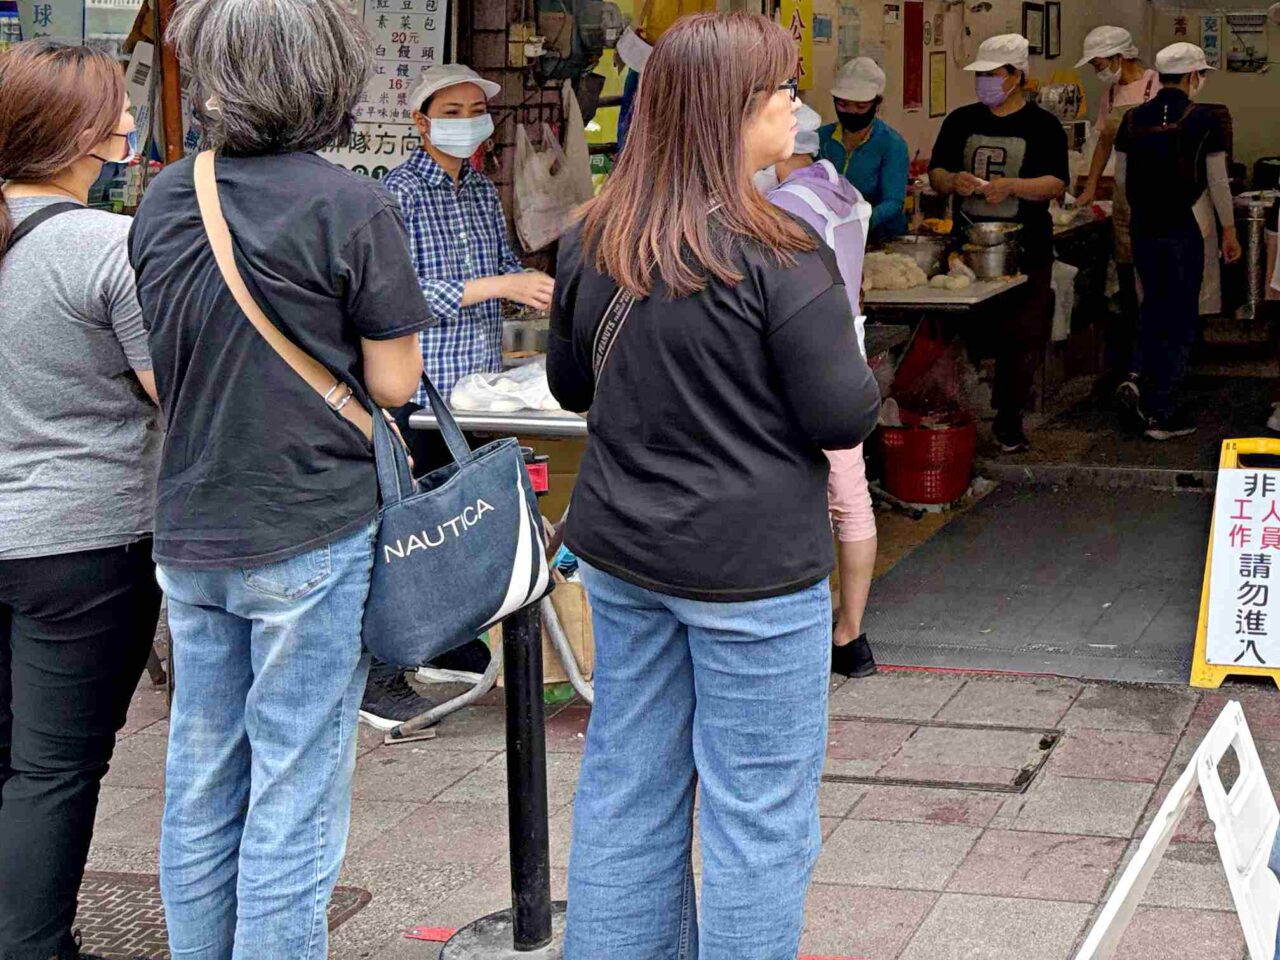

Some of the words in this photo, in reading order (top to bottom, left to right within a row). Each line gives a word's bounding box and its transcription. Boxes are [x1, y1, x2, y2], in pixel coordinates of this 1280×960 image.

[375, 15, 436, 31] 素菜包
[391, 32, 419, 45] 20元
[375, 44, 434, 59] 白饅頭
[383, 498, 495, 563] NAUTICA
[1233, 553, 1273, 665] 請勿進入
